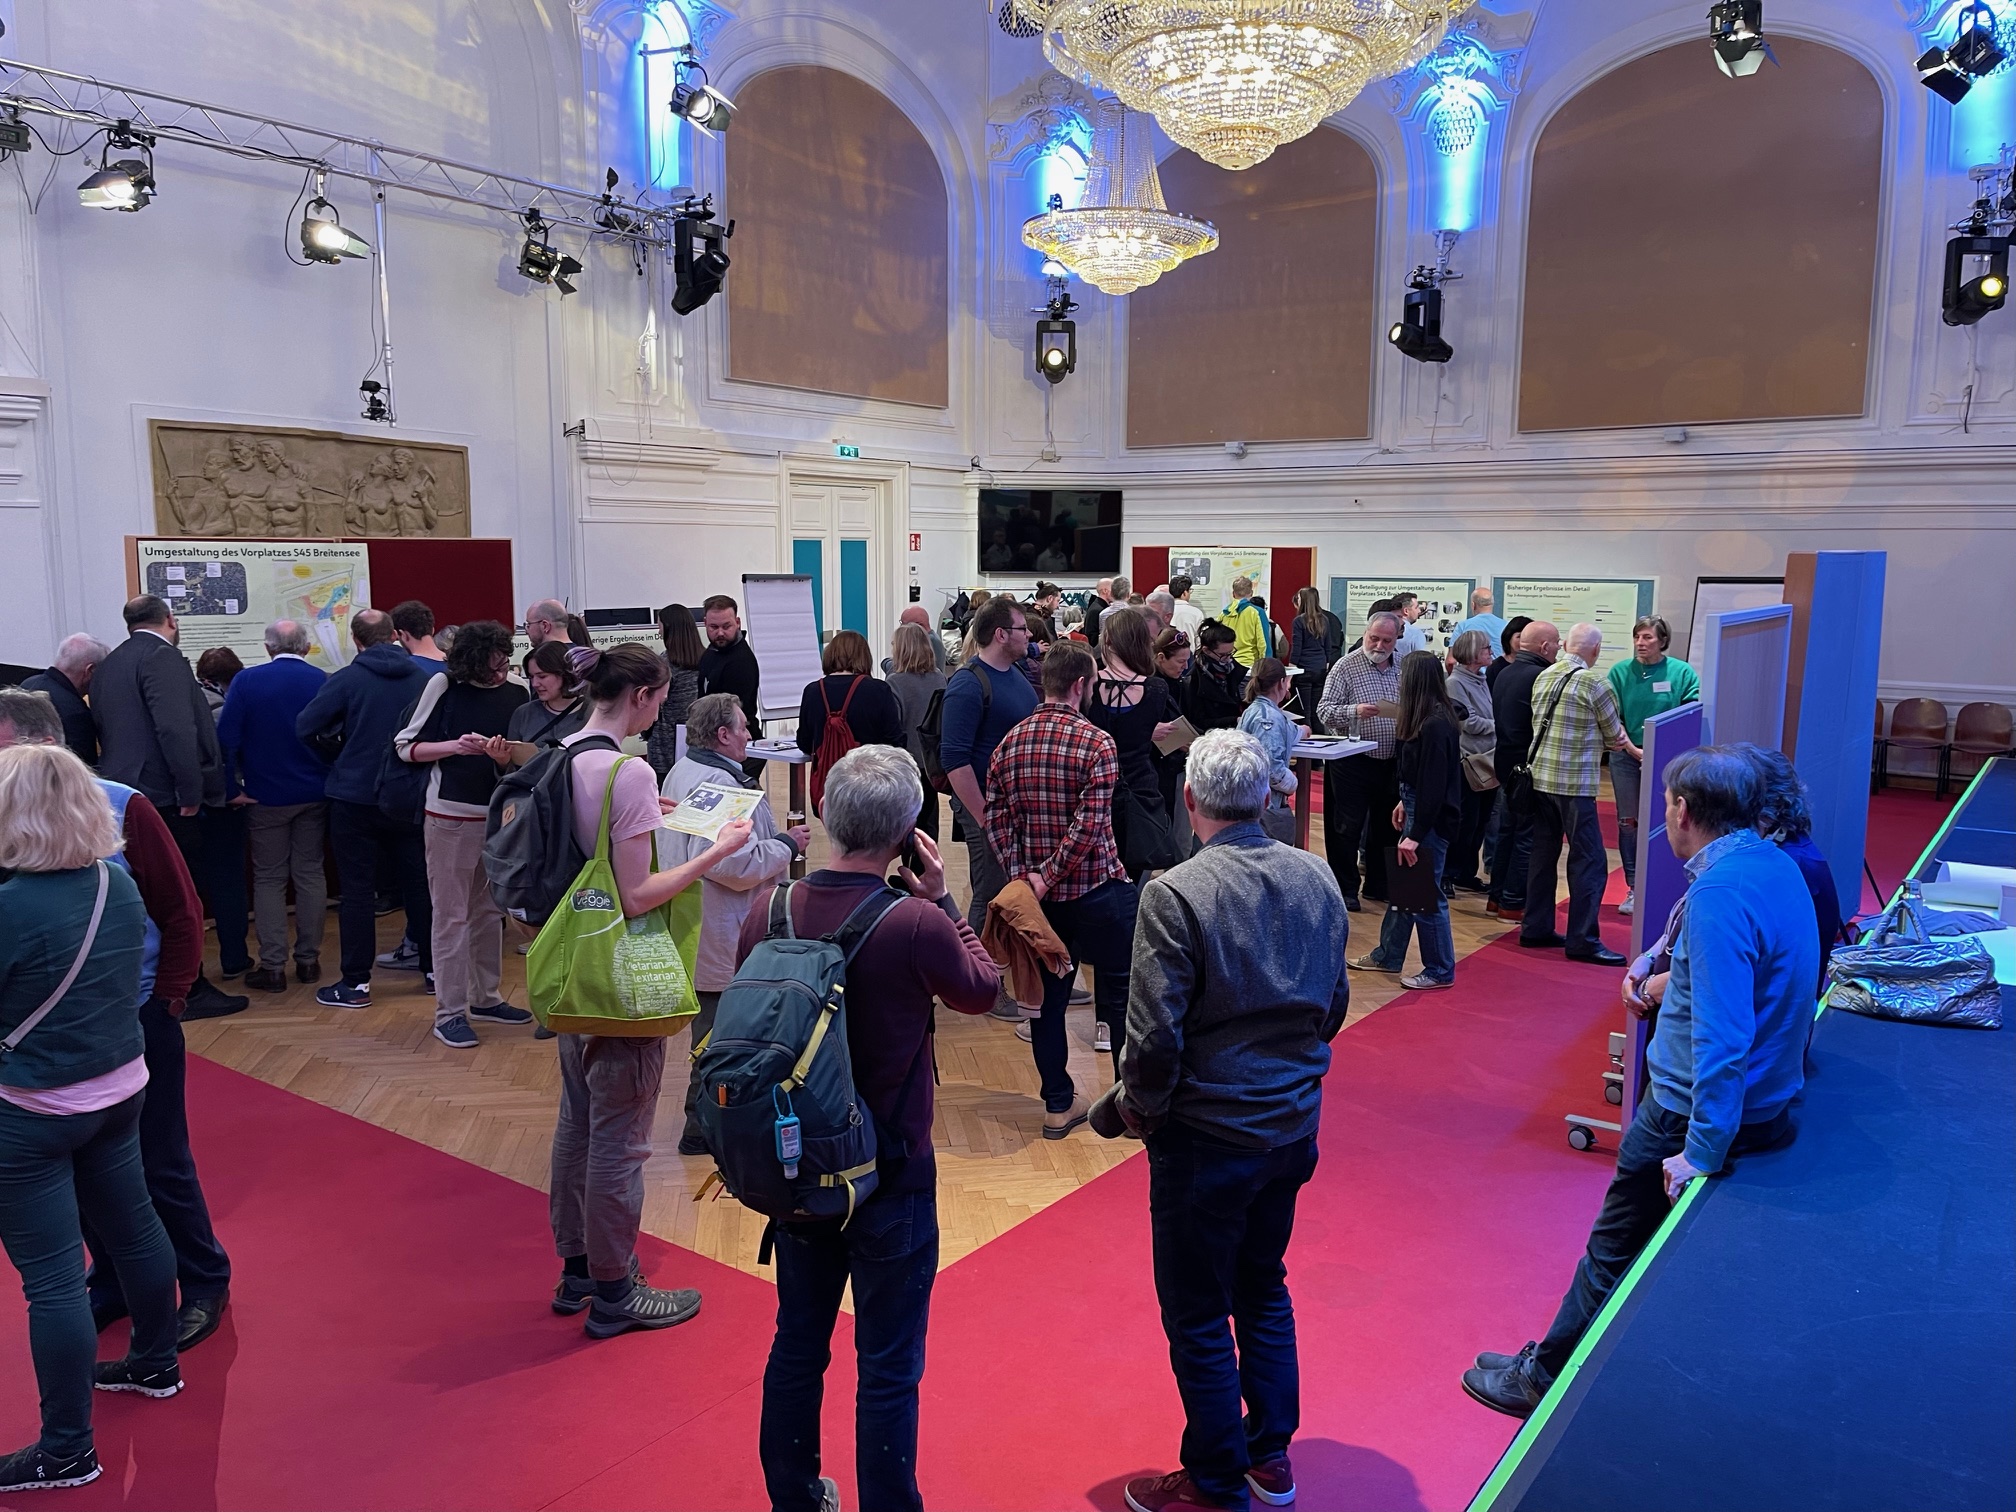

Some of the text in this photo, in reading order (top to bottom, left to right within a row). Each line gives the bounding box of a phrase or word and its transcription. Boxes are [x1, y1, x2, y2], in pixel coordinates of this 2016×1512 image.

[144, 546, 361, 559] Umgestaltung des Vorplatzes S45 Breitensee
[1398, 584, 1435, 592] Umgestaltung
[1507, 584, 1533, 592] Bisherige
[1533, 584, 1563, 592] Ergebnisse
[609, 635, 645, 644] Ergebnisse
[645, 633, 653, 641] im
